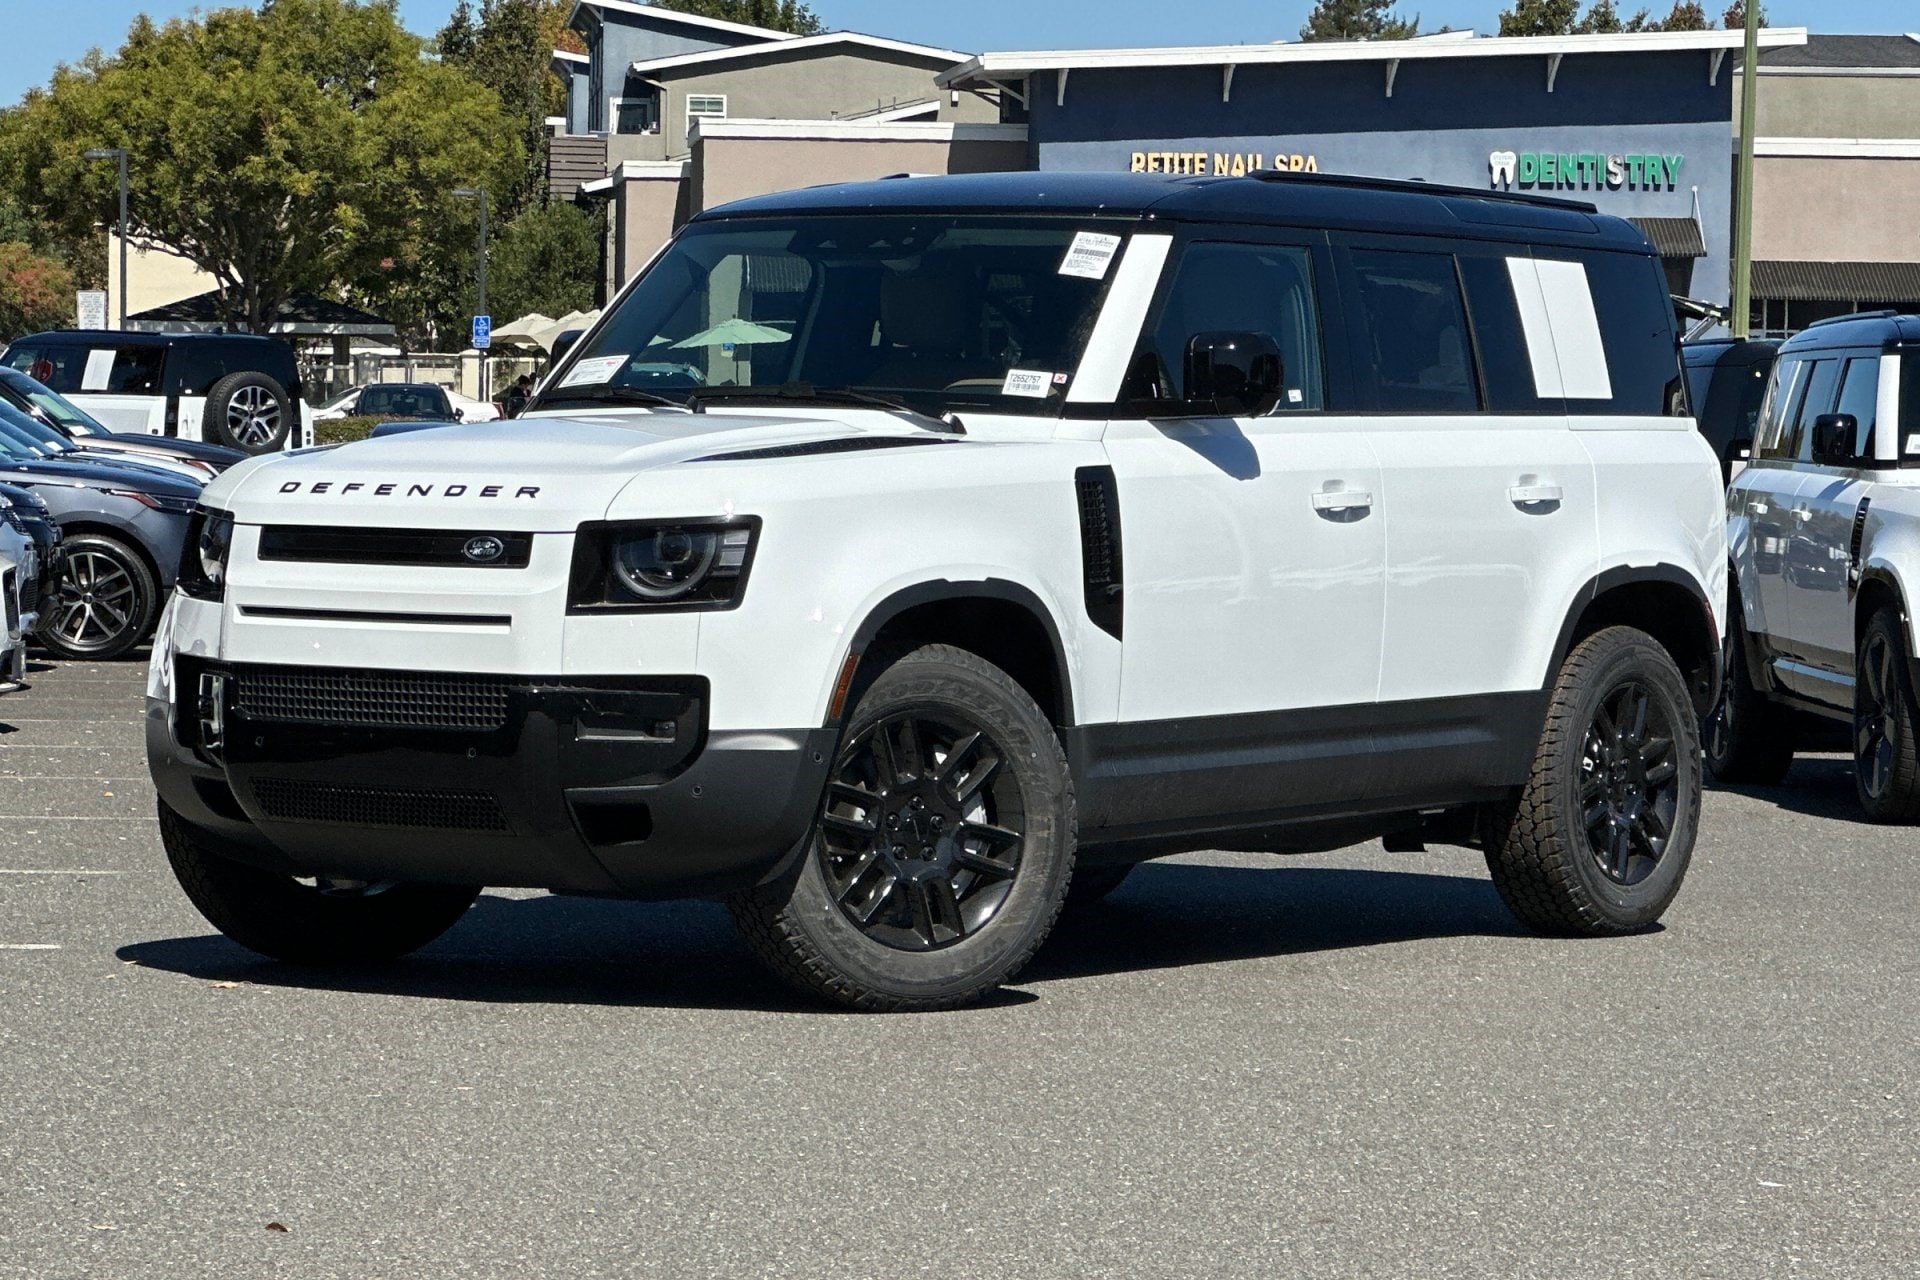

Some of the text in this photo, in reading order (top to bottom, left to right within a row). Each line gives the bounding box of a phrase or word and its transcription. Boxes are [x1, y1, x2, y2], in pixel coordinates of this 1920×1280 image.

[1131, 152, 1208, 176] PETITE
[1274, 154, 1318, 174] SPA
[1519, 152, 1685, 185] DENTISTRY
[278, 481, 541, 499] DEFENDER
